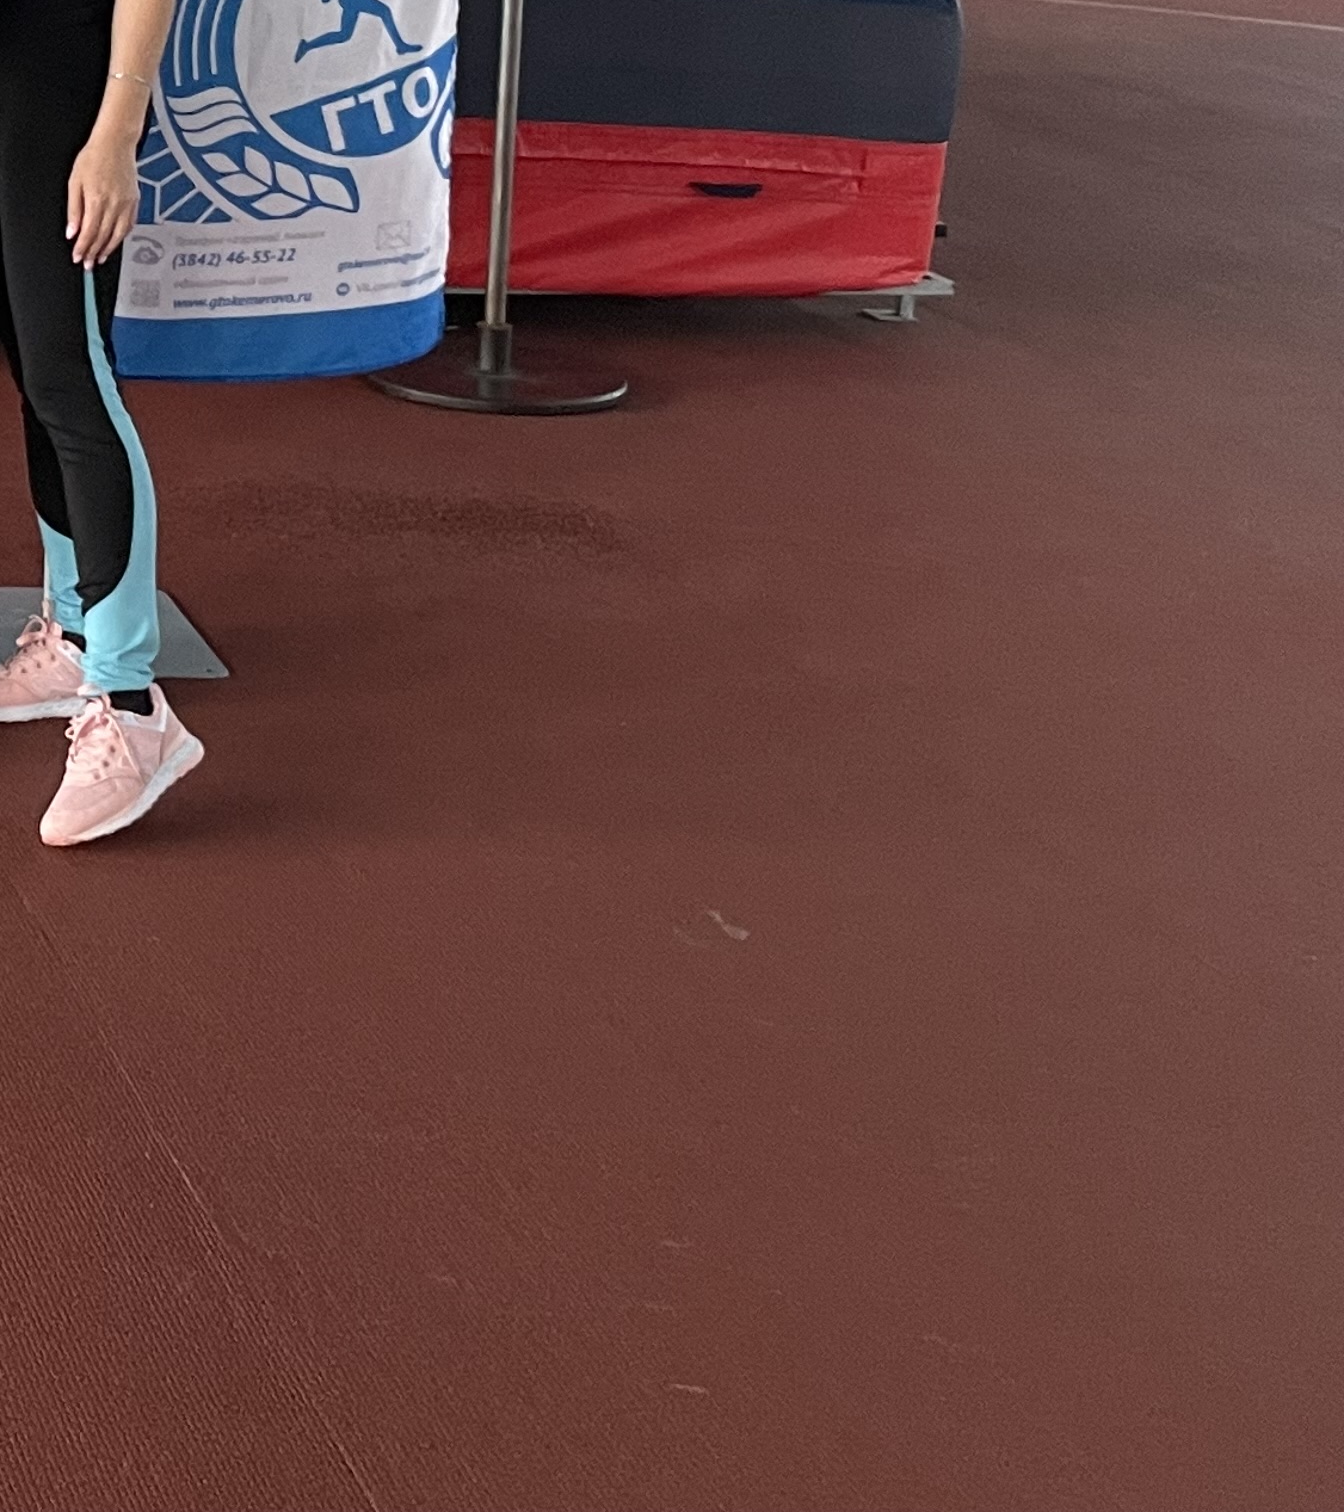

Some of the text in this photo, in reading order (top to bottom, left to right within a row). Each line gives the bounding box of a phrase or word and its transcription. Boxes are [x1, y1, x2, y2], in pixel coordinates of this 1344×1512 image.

[321, 66, 439, 152] ГТО
[172, 248, 296, 270] (3842) 46-55-22
